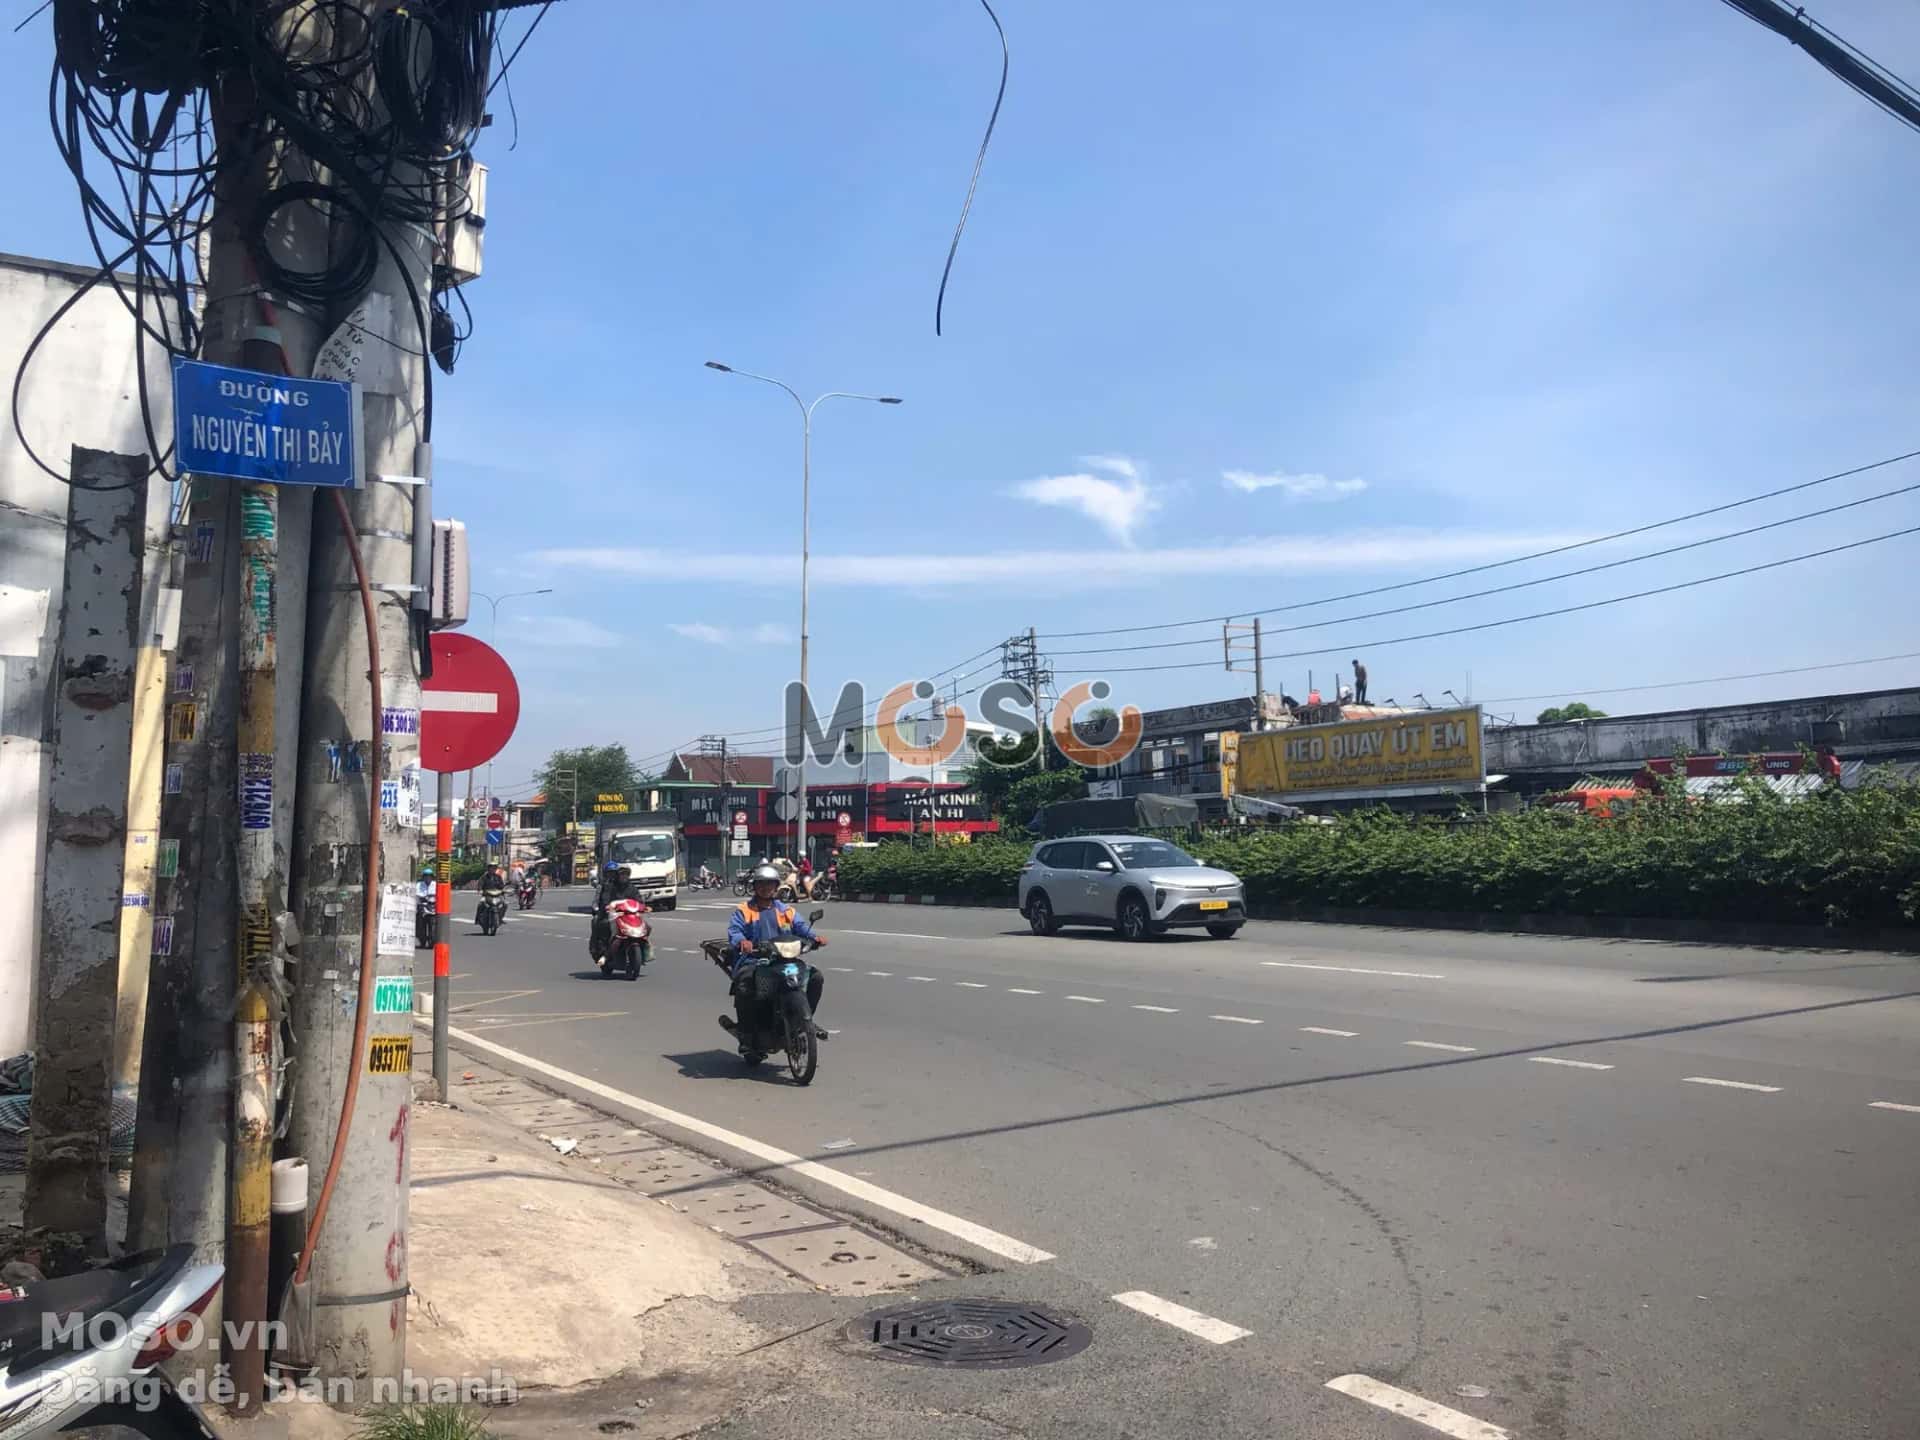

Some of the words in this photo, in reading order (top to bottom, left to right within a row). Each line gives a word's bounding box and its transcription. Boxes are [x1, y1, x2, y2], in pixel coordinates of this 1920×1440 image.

[219, 379, 310, 407] ĐƯỜNG
[192, 406, 267, 459] NGUYỄN
[271, 425, 301, 468] THỊ
[308, 420, 343, 465] BẢY
[1329, 729, 1385, 764] QUAY
[1431, 720, 1467, 750] EM
[1766, 761, 1790, 769] UNIC
[815, 791, 852, 807] KÍNH
[920, 808, 942, 818] AN
[946, 808, 963, 818] HI
